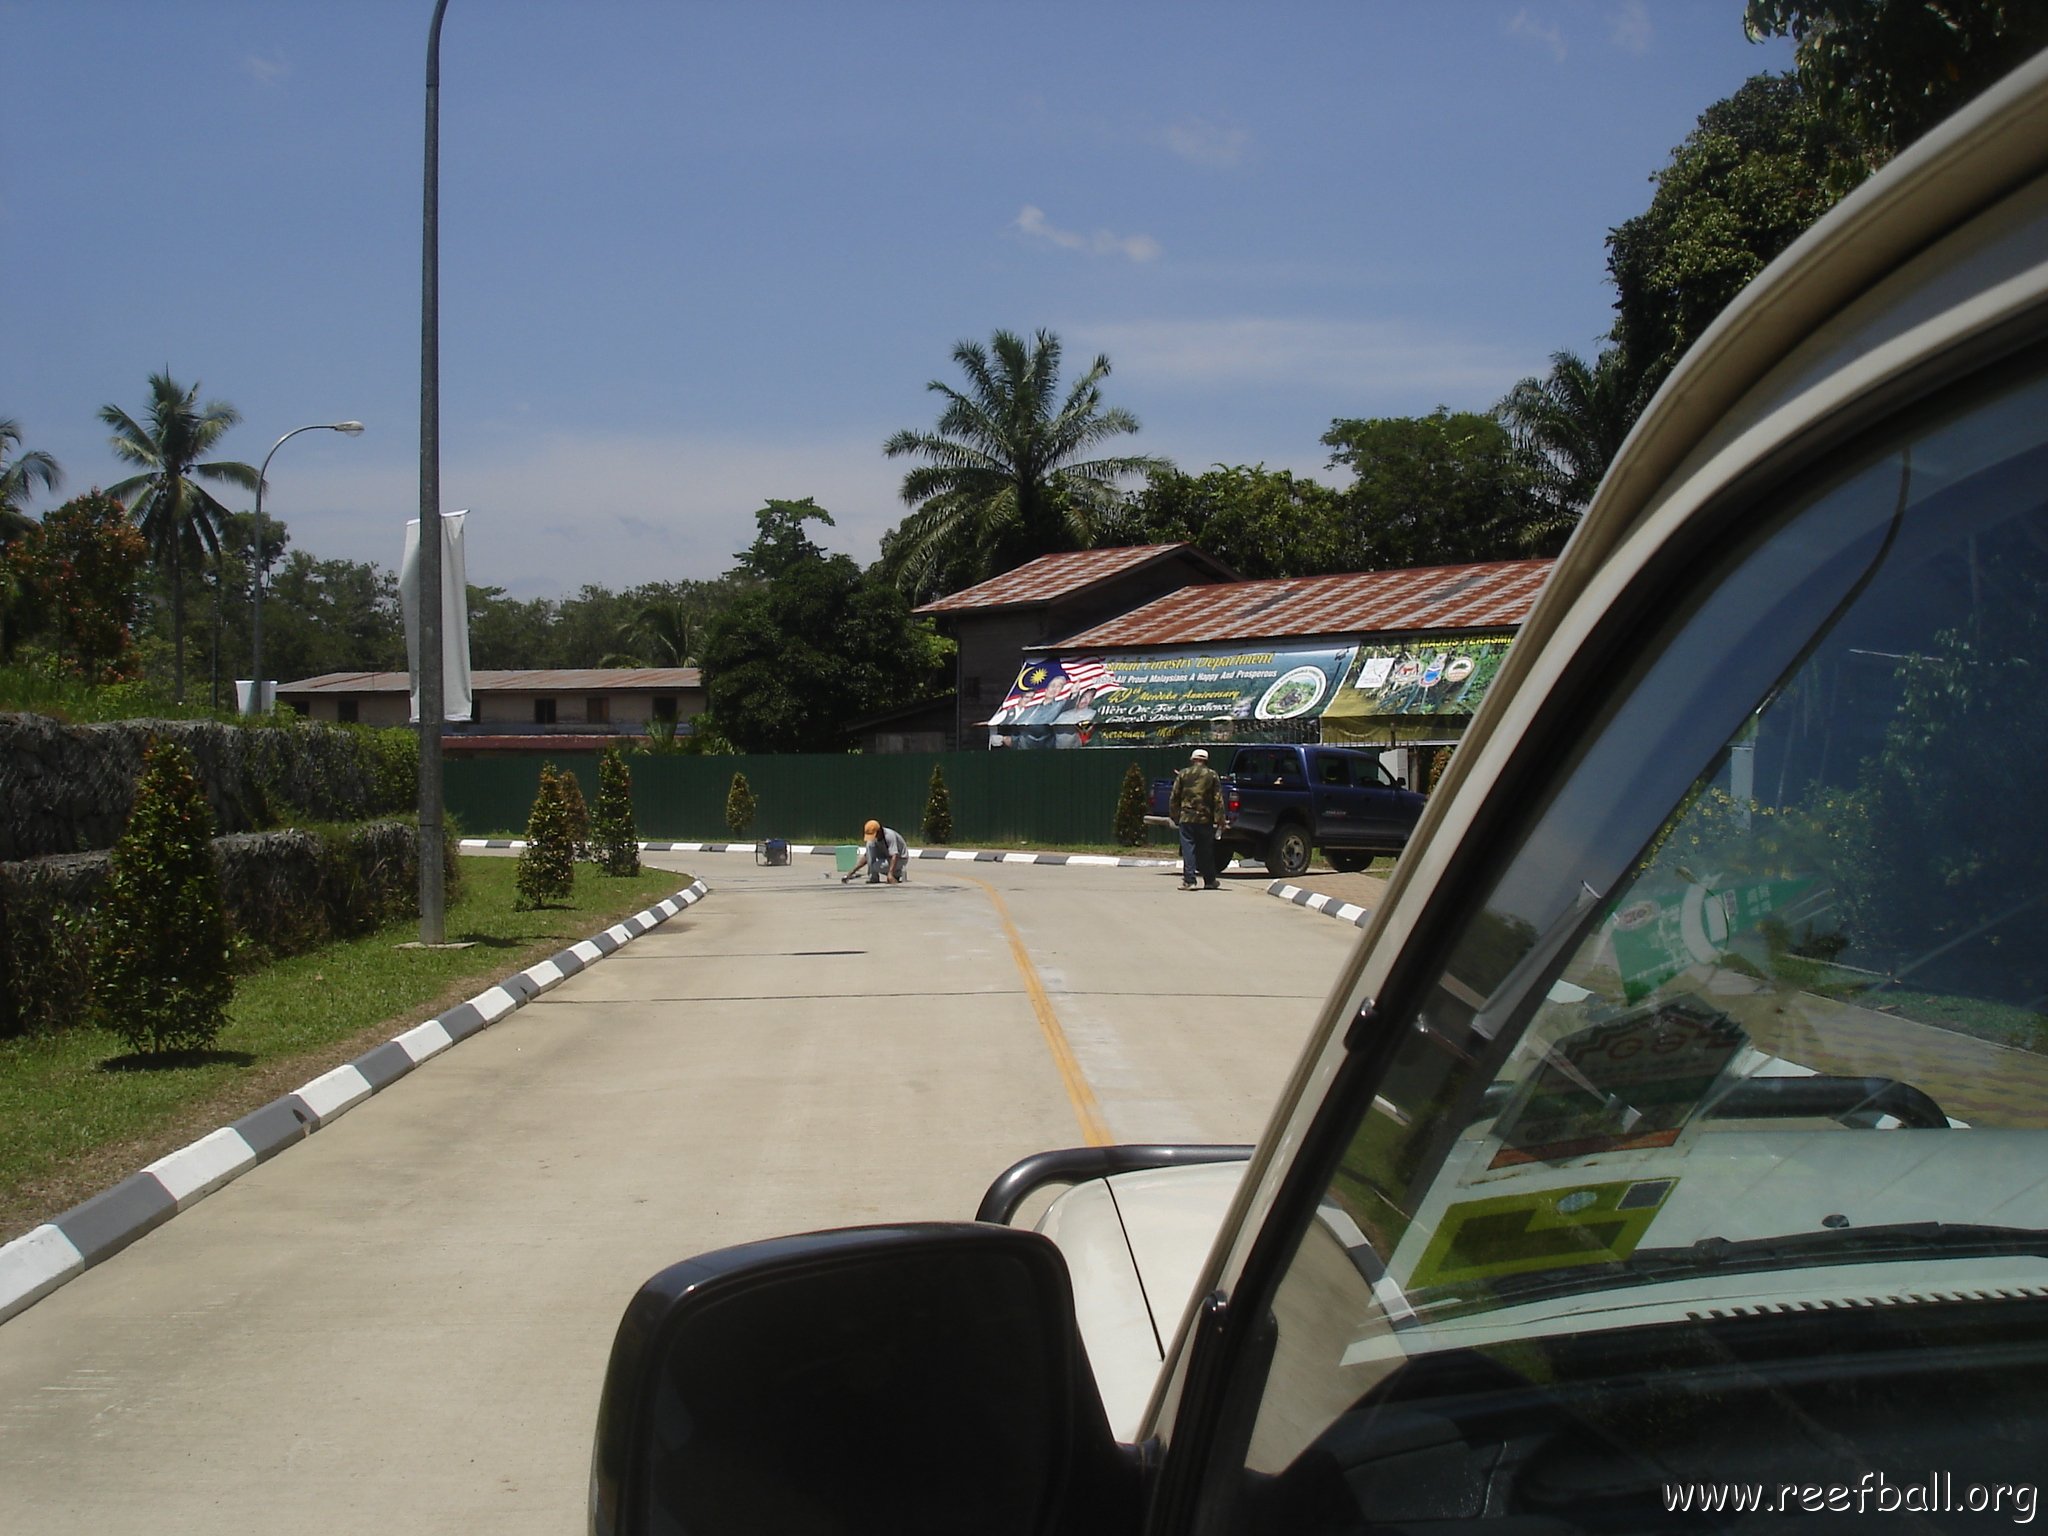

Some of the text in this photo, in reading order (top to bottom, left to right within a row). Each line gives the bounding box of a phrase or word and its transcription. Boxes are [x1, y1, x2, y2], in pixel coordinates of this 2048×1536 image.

[1196, 654, 1275, 671] Department
[1127, 674, 1149, 683] Proud
[1149, 673, 1188, 684] Malaysians
[1189, 672, 1196, 682] A
[1197, 672, 1219, 682] Happy
[1220, 671, 1236, 680] And
[1236, 669, 1278, 680] Prosperous
[1179, 689, 1240, 701] Anniversary
[1151, 703, 1176, 714] For
